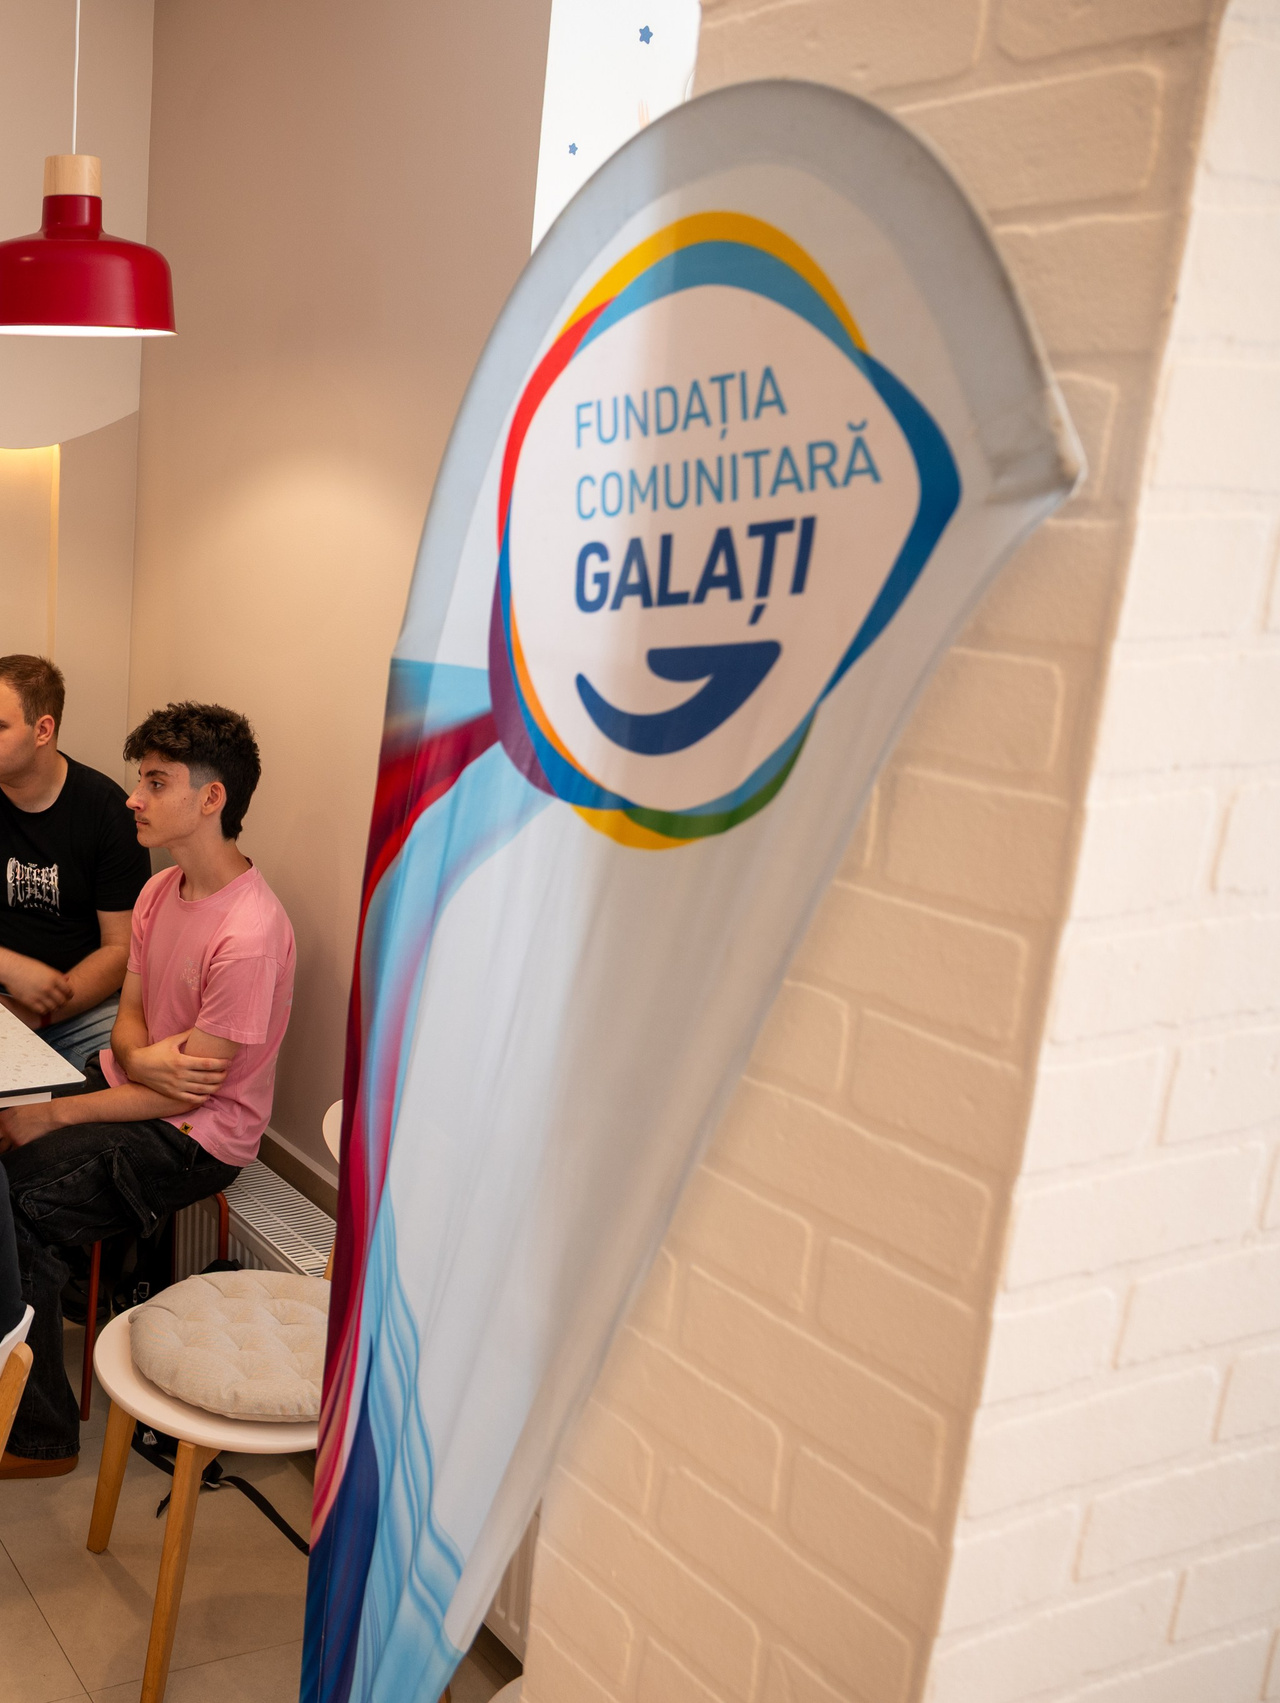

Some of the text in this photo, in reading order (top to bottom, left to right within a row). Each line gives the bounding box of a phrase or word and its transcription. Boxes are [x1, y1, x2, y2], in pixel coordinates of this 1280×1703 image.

[575, 366, 787, 449] FUNDAȚIA
[576, 420, 881, 520] COMUNITARĂ
[575, 515, 817, 625] GALAȚI
